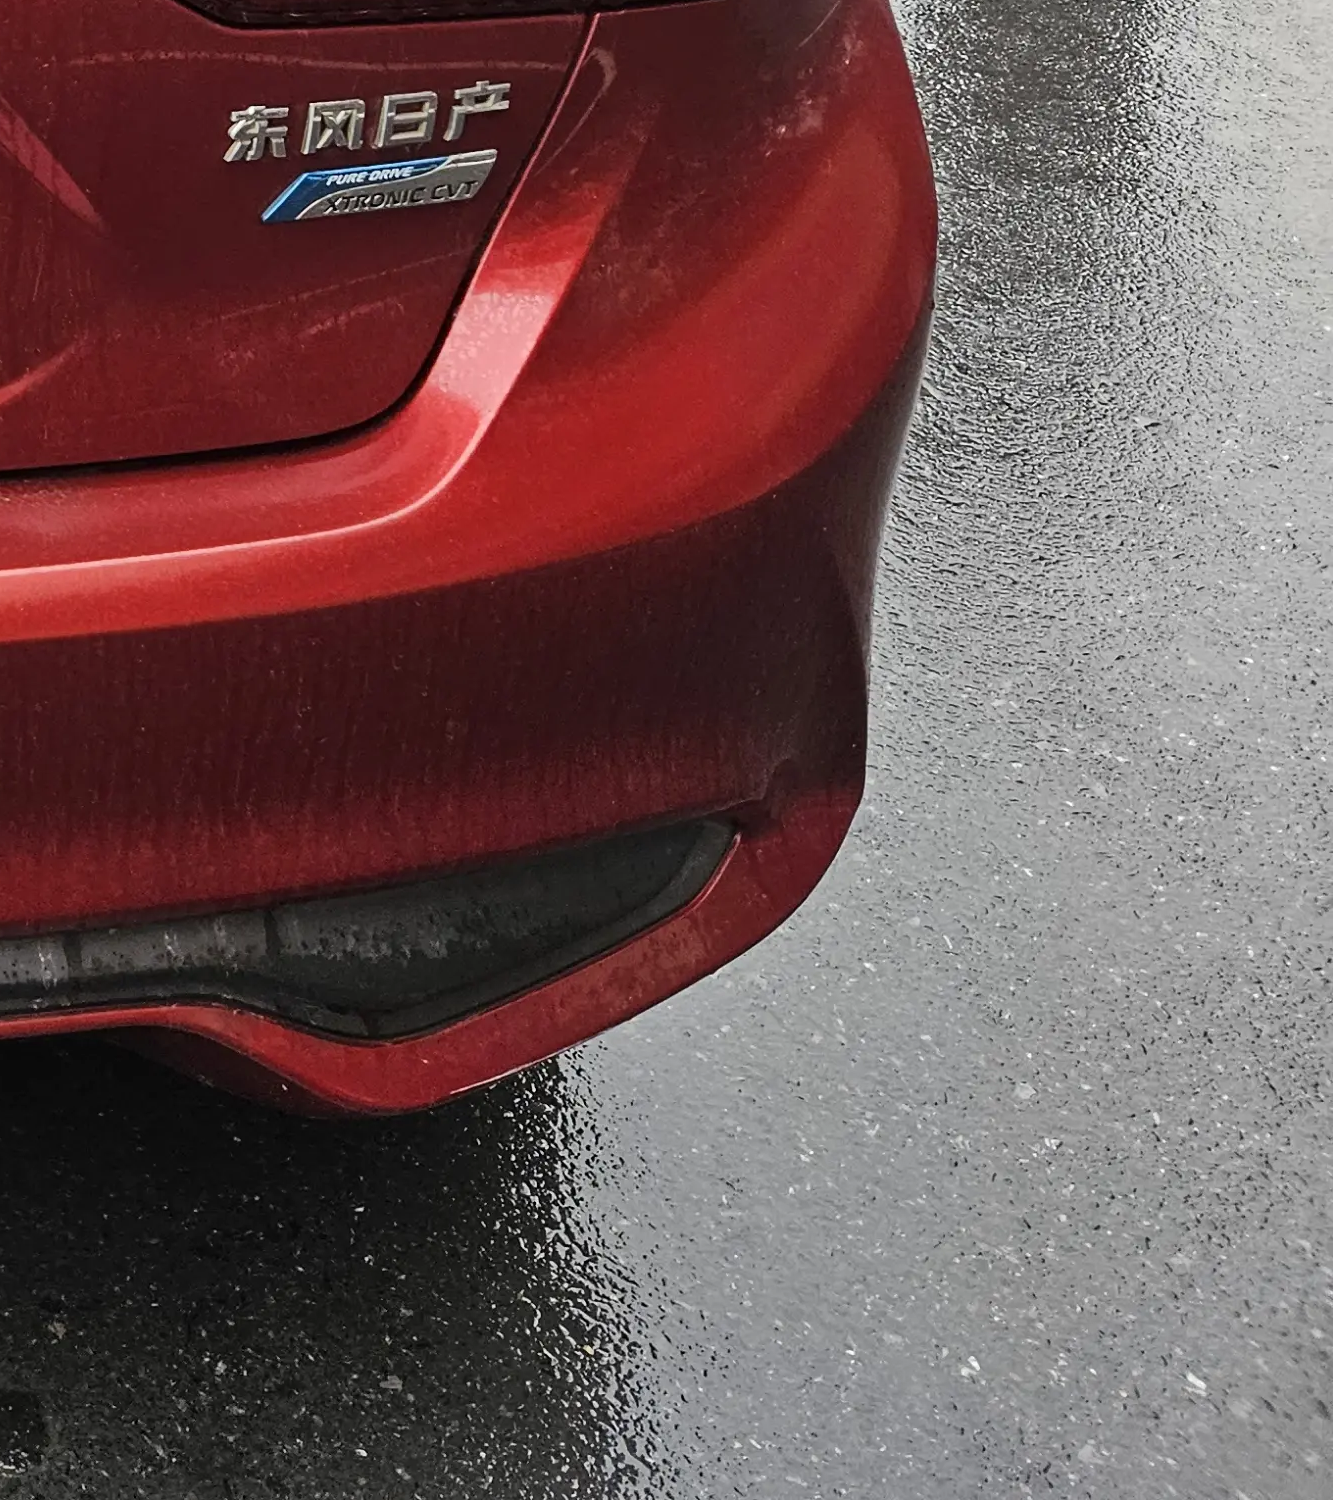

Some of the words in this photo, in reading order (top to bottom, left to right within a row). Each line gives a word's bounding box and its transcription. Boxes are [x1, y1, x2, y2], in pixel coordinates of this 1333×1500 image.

[223, 80, 512, 162] 东风日产
[325, 172, 366, 186] PURE
[368, 166, 414, 182] DRIVE
[323, 186, 426, 215] XTRONIC
[430, 180, 479, 200] CVT
